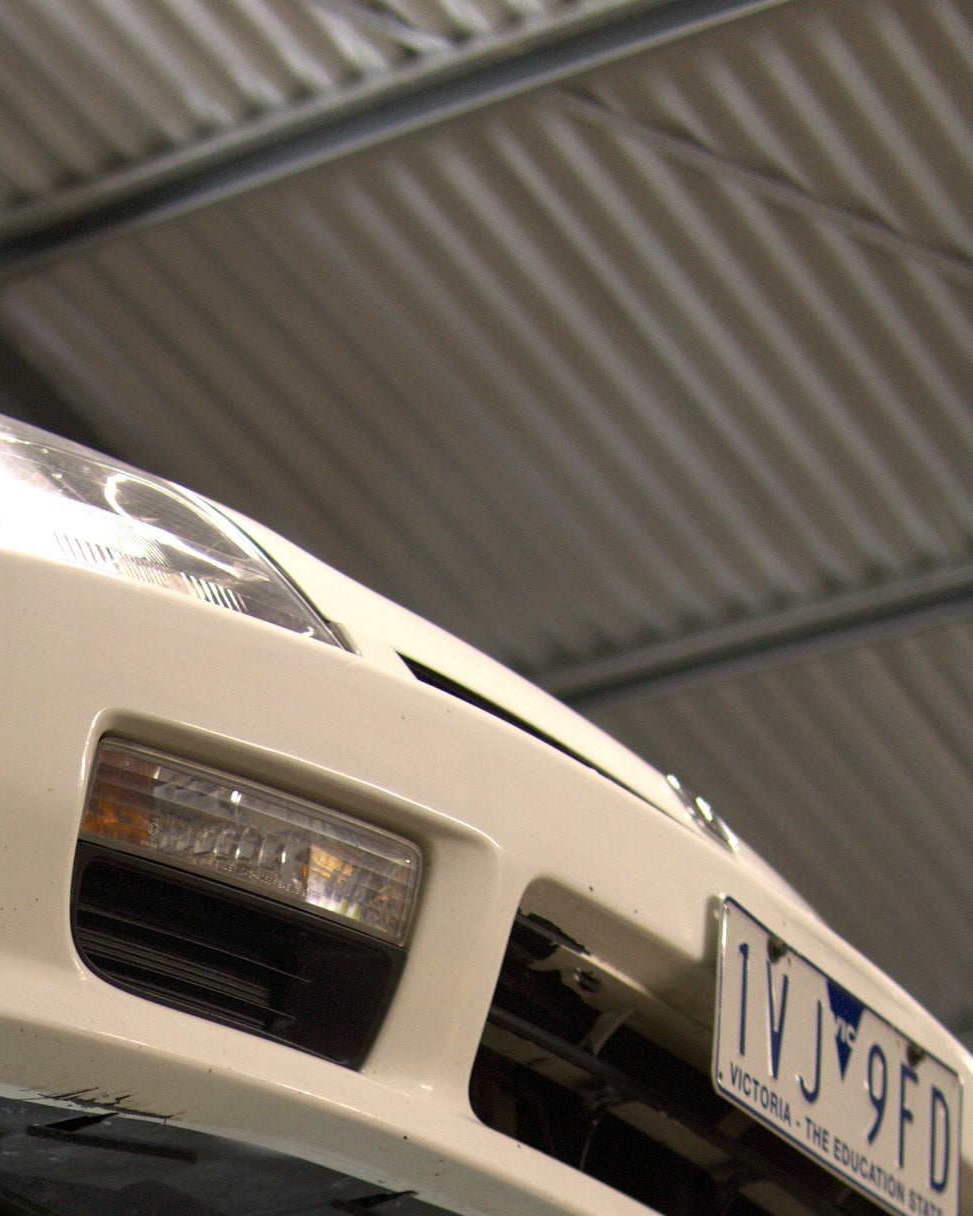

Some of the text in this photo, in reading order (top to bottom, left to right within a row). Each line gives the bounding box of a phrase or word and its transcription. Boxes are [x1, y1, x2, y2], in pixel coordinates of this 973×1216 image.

[833, 1014, 857, 1047] VIC
[729, 1060, 791, 1127] VICTORIA
[805, 1116, 830, 1153] THE
[834, 1137, 905, 1206] EDUCATION
